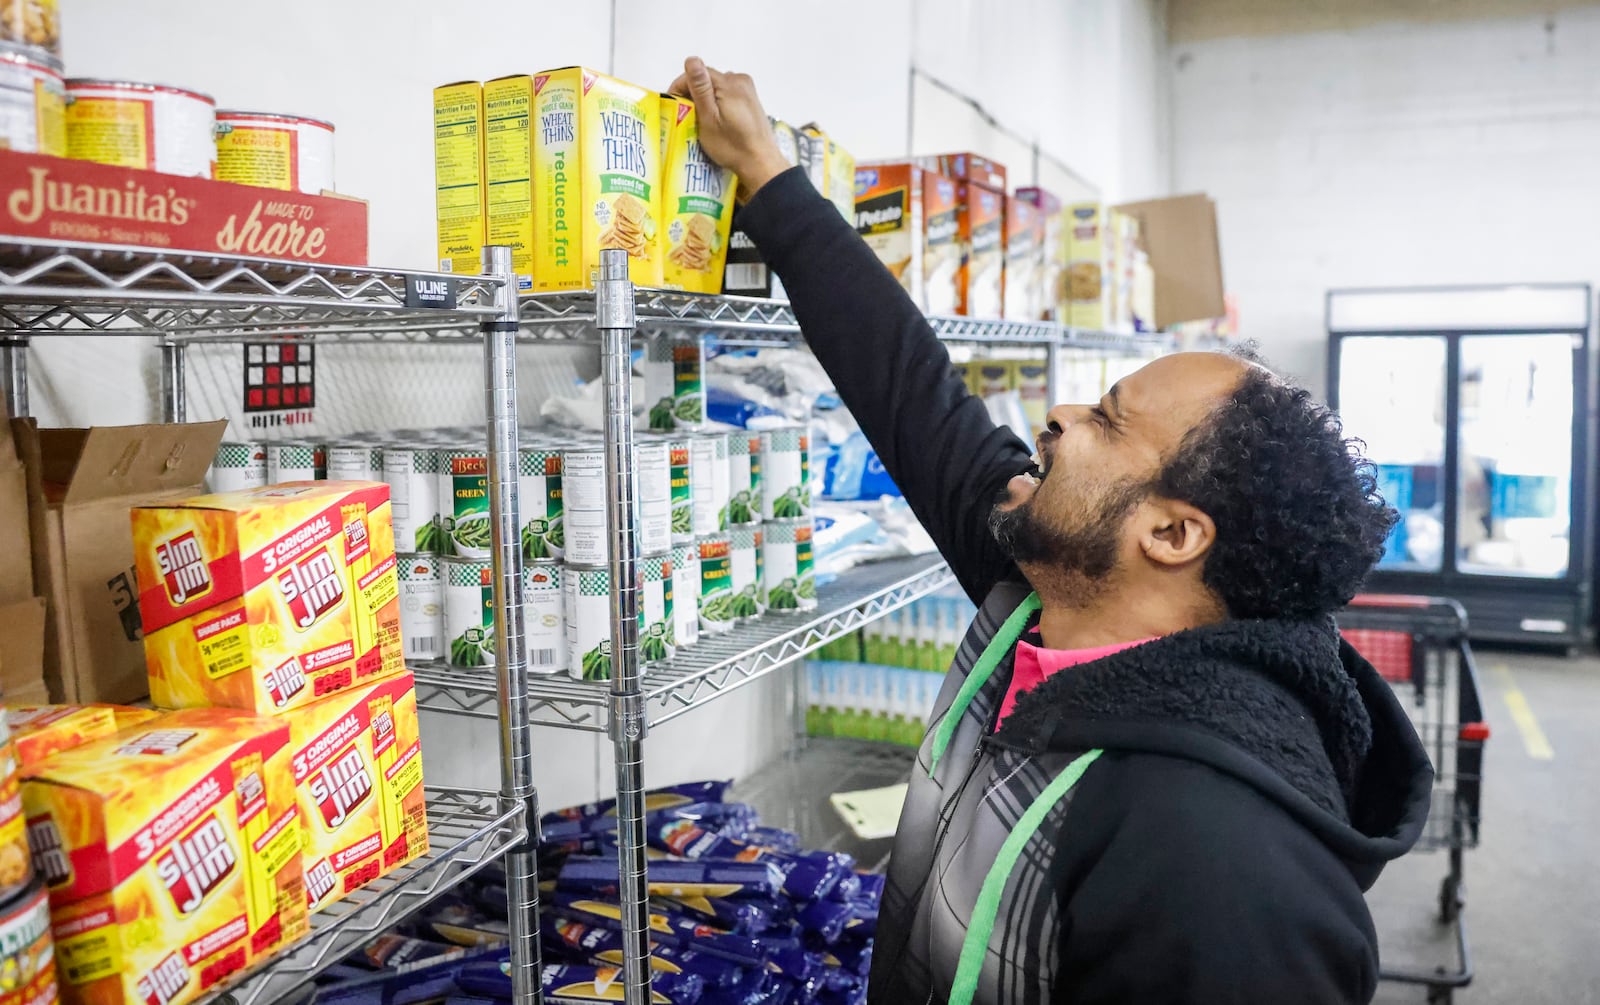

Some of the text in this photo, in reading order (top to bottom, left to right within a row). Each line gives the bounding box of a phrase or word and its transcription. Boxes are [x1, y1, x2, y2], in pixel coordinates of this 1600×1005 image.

[436, 106, 459, 115] Nutrition
[487, 97, 528, 109] Nutrition Facts
[558, 102, 574, 110] GRAIN
[465, 125, 477, 133] 120
[517, 119, 529, 127] 120
[541, 112, 575, 127] WHEAT
[600, 111, 646, 145] WHEAT
[610, 177, 635, 188] reduced
[8, 167, 190, 225] Juanita's
[264, 201, 314, 220] MADE TO
[555, 151, 568, 267] reduced fat
[216, 200, 326, 259] share
[415, 280, 448, 295] ULINE
[458, 459, 486, 474] Beck
[456, 489, 486, 498] GREEN
[262, 516, 331, 573] 3 ORIGINAL
[158, 536, 202, 576] slim
[380, 558, 394, 573] PACK
[279, 550, 336, 603] slim
[371, 574, 393, 592] PROTEIN
[405, 584, 416, 594] NO
[196, 612, 242, 638] SHARE PACK
[211, 635, 240, 650] PROTEIN
[304, 643, 352, 670] 3 ORIGINAL
[264, 659, 301, 694] slim
[293, 713, 359, 780] 3 ORIGINAL
[405, 745, 418, 762] PACK
[310, 748, 365, 806] slim
[397, 761, 417, 782] PROTEIN
[135, 828, 155, 860] 3
[157, 817, 226, 889] slim
[335, 835, 380, 869] 3 ORIGINAL
[303, 860, 331, 889] lim
[188, 943, 201, 963] 3
